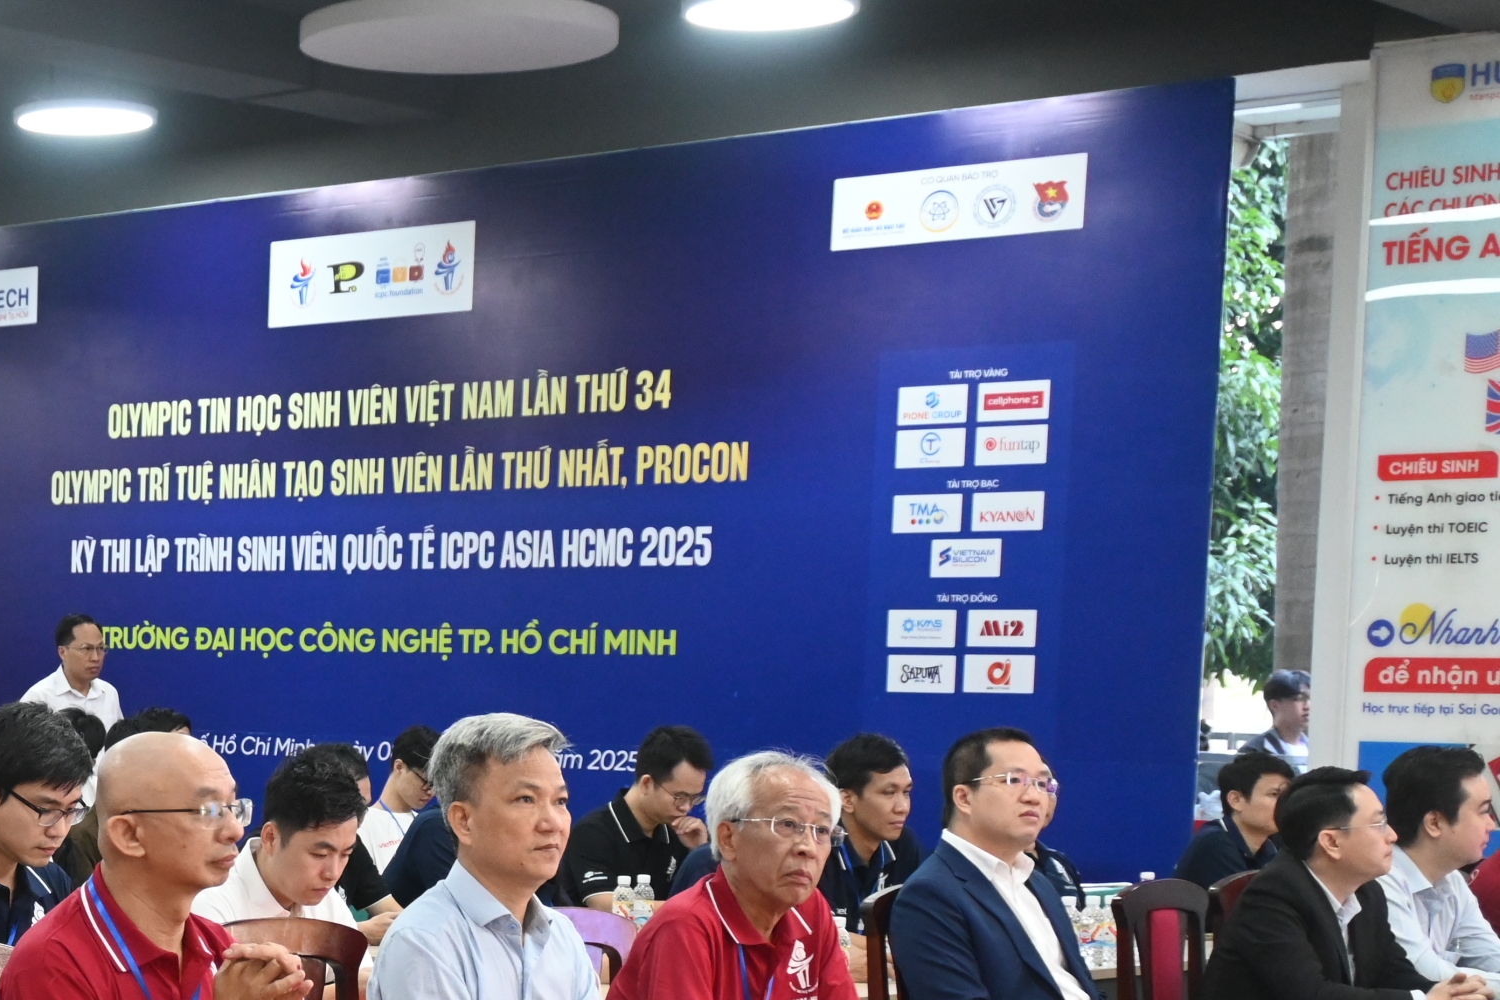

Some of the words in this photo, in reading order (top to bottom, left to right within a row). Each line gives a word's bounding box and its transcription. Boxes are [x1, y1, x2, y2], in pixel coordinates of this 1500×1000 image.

[936, 175, 959, 184] QUAN
[1386, 166, 1445, 191] CHIÊU
[1452, 163, 1500, 185] SINH
[1383, 228, 1470, 265] TIẾNG
[949, 370, 962, 379] TÀI
[964, 370, 982, 380] TRỢ
[983, 368, 1008, 377] VÀNG
[108, 399, 191, 439] OLYMPIC
[198, 397, 230, 434] TIN
[236, 394, 281, 436] HỌC
[288, 391, 340, 430] SINH
[348, 384, 397, 426] VIÊN
[405, 380, 454, 427] VIỆT
[462, 379, 514, 420] NAM
[522, 369, 567, 416] LẦN
[576, 367, 628, 413] THỨ
[635, 369, 671, 410] 34
[904, 411, 929, 420] PIONE
[932, 410, 962, 419] GROUP
[1000, 436, 1040, 453] funtap
[51, 468, 131, 505] OLYMPIC
[138, 462, 171, 502] TRÍ
[176, 461, 213, 505] TUỆ
[219, 459, 276, 499] NHÂN
[283, 460, 323, 502] TẠO
[330, 457, 384, 496] SINH
[392, 452, 442, 493] VIÊN
[450, 446, 493, 491] LẦN
[502, 445, 551, 490] THỨ
[558, 439, 627, 488] NHẤT,
[636, 441, 749, 485] PROCON
[1389, 458, 1437, 475] CHIÊU
[1442, 459, 1479, 473] SINH
[947, 480, 960, 488] TÀI
[962, 480, 979, 489] TRỢ
[981, 479, 999, 490] BẠC
[1388, 492, 1422, 506] Tiếng
[1427, 493, 1452, 503] Anh
[1456, 494, 1485, 505] giao
[910, 502, 939, 516] TMA
[1386, 524, 1423, 537] Luyện
[1428, 523, 1444, 533] thi
[1448, 522, 1488, 533] TOEIC
[71, 536, 96, 573] KỲ
[101, 539, 130, 573] THI
[135, 534, 169, 577] LẬP
[175, 533, 232, 572] TRÌNH
[237, 536, 285, 572] SINH
[291, 531, 336, 571] VIÊN
[342, 525, 403, 574] QUỐC
[409, 525, 435, 569] TẾ
[441, 531, 495, 569] ICPC
[500, 530, 555, 568] ASIA
[562, 528, 633, 567] HCMC
[640, 526, 713, 566] 2025
[1384, 554, 1421, 567] Luyện
[1426, 554, 1442, 564] thi
[1446, 553, 1479, 564] IELTS
[936, 593, 949, 602] TÀI
[951, 594, 969, 604] TRỢ
[970, 592, 998, 602] ĐỒNG
[917, 619, 942, 627] KMS
[980, 620, 1024, 636] Mi2
[102, 621, 189, 650] TRƯỜNG
[195, 628, 234, 657] ĐẠI
[241, 628, 293, 658] HỌC
[300, 622, 376, 652] CÔNG
[382, 622, 452, 660] NGHỆ
[459, 629, 493, 654] TP.
[502, 619, 542, 655] HỒ
[549, 622, 598, 655] CHÍ
[604, 630, 676, 656] MINH
[901, 664, 941, 684] SAPUWA
[1379, 659, 1409, 684] để
[1417, 665, 1478, 690] nhận
[1363, 703, 1384, 715] Học
[1389, 703, 1409, 716] trực
[1414, 702, 1435, 717] tiếp
[1439, 703, 1453, 715] tại
[1459, 703, 1476, 715] Sai
[213, 734, 237, 755] Hồ
[241, 736, 271, 756] Chí
[587, 749, 638, 772] 2025
